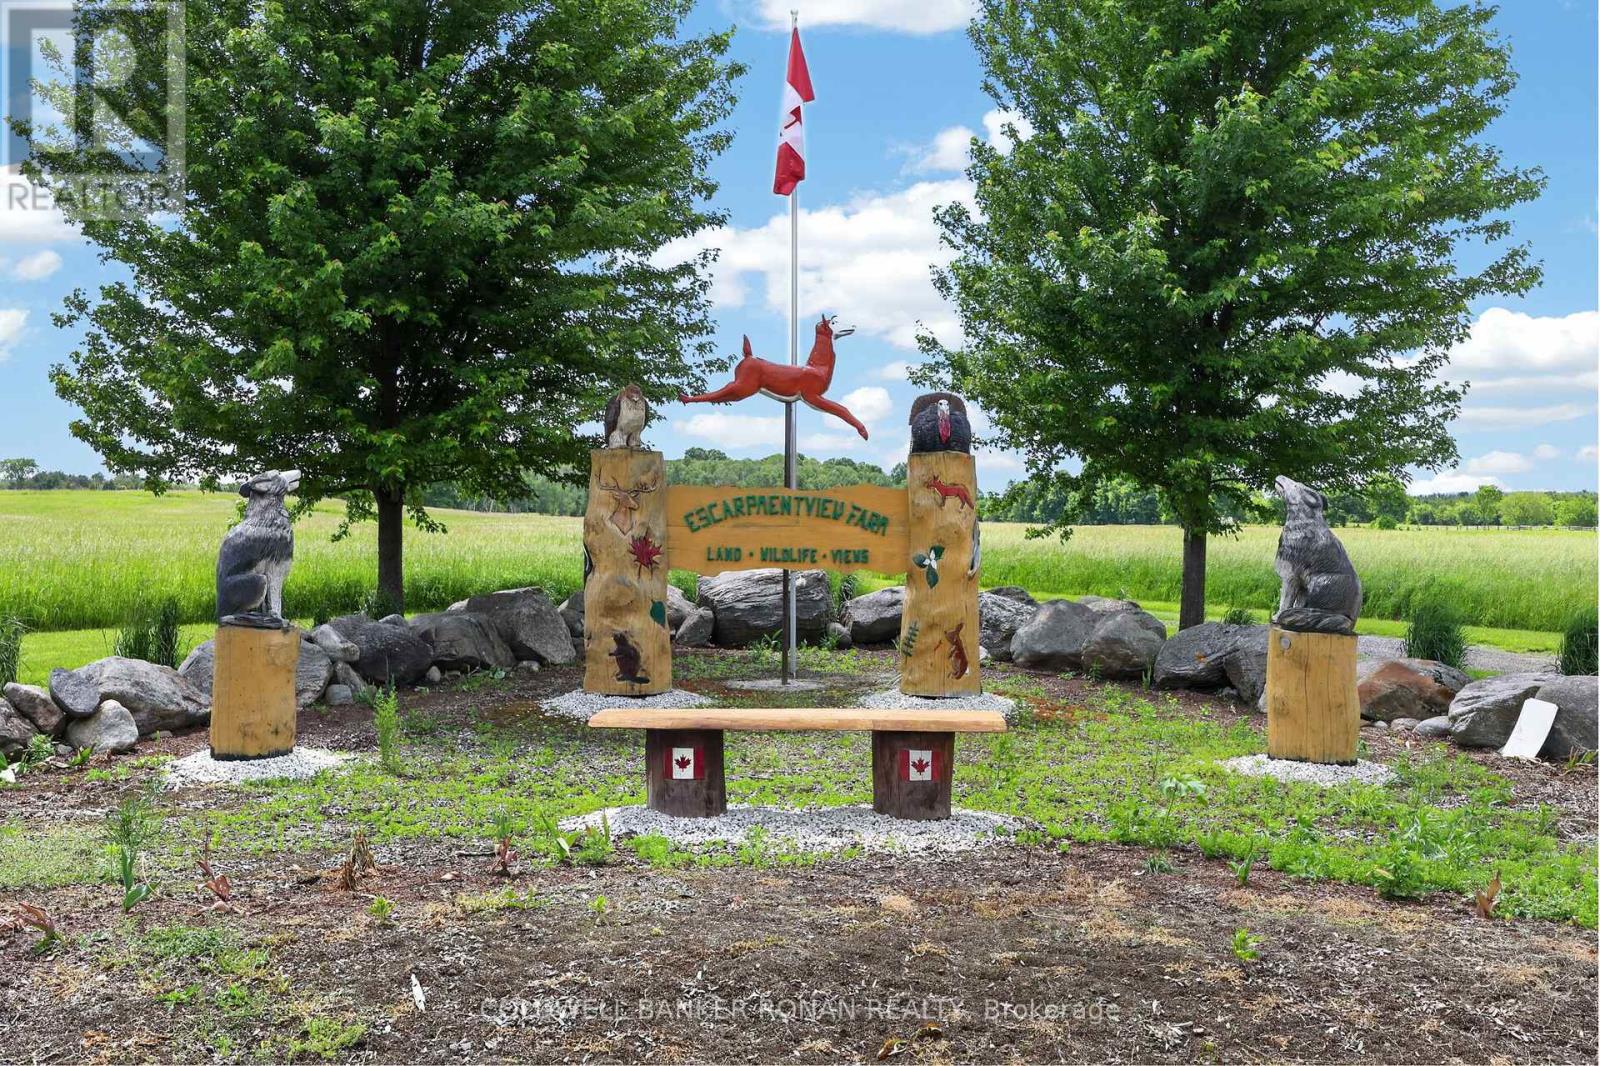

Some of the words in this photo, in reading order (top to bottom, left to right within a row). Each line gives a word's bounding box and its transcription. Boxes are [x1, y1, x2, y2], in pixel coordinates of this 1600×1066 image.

[684, 495, 845, 533] ESCARPMENTVIEW
[845, 503, 889, 536] FARM
[706, 546, 742, 562] LAND
[760, 547, 817, 563] WILDLIFE
[831, 549, 869, 564] VIEWS
